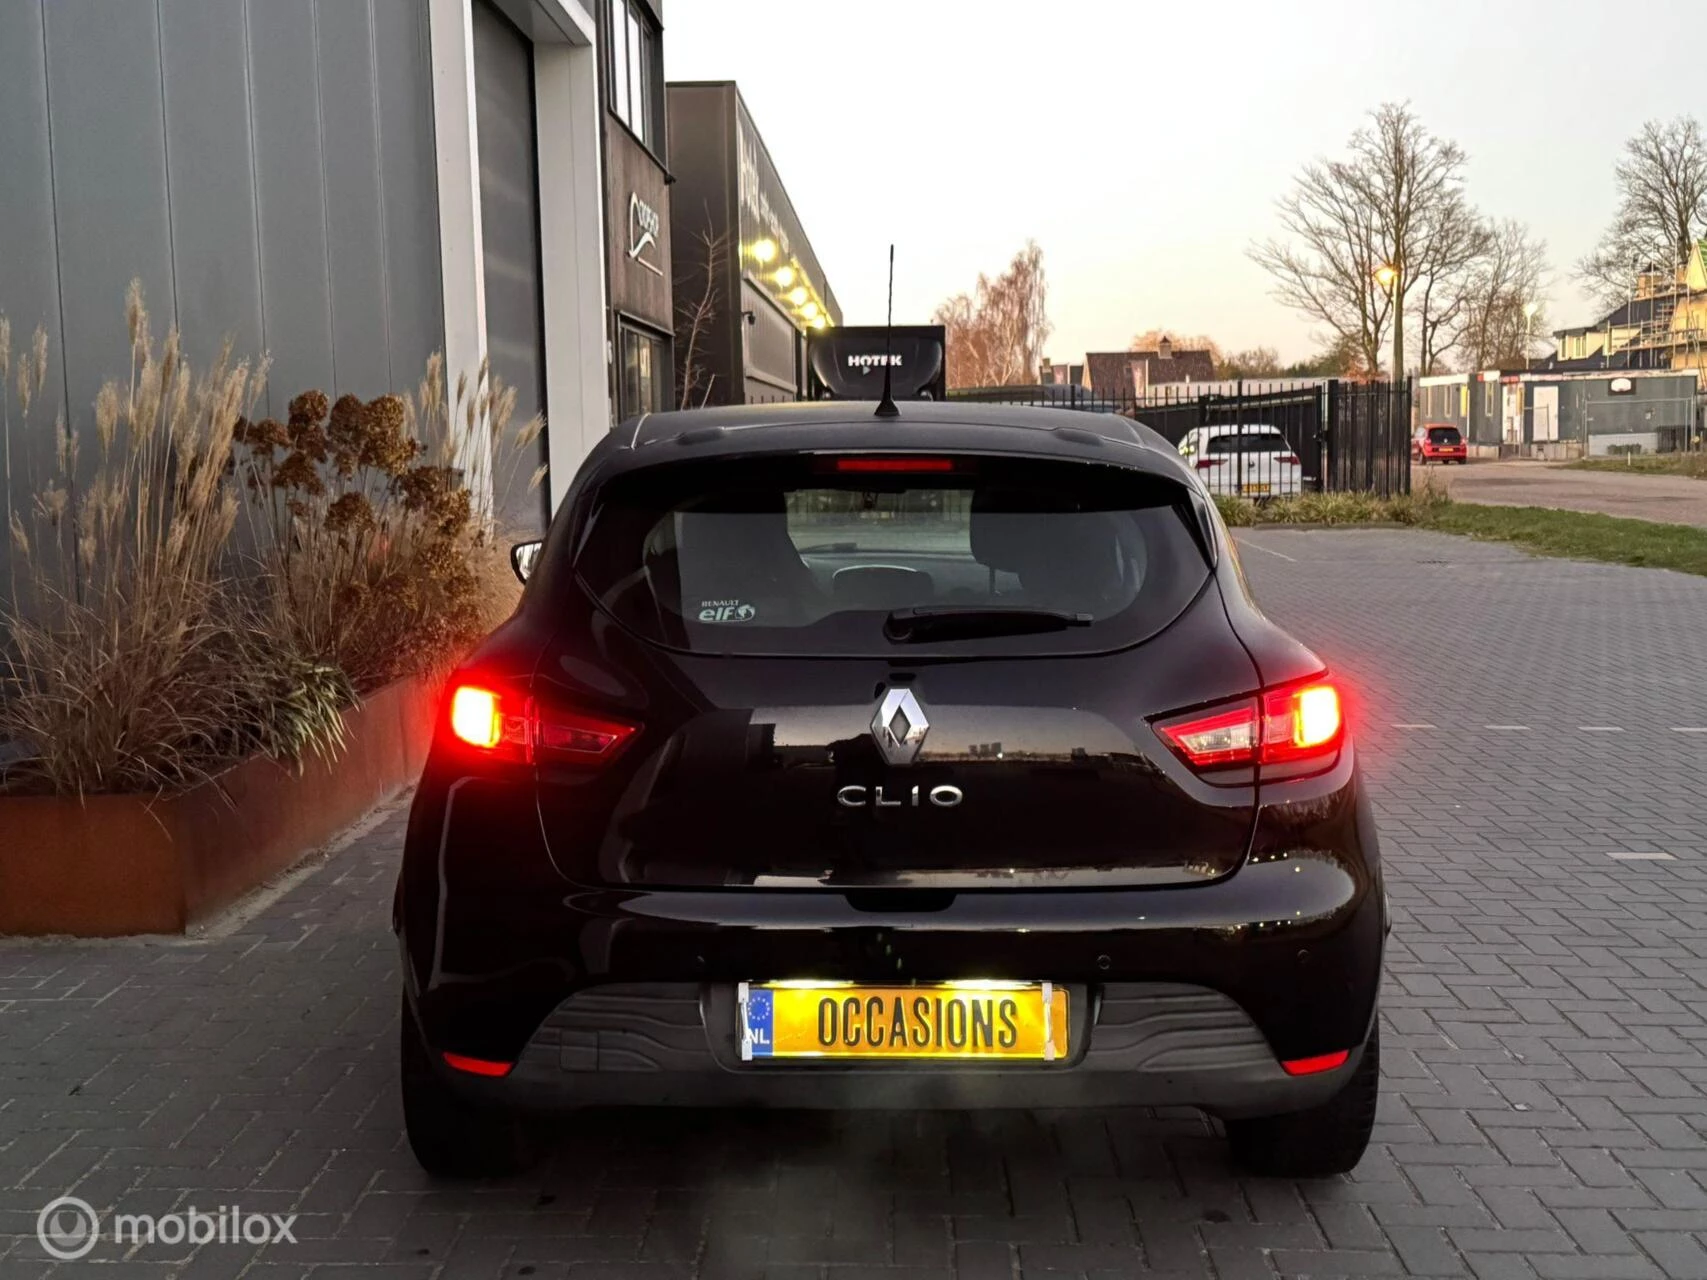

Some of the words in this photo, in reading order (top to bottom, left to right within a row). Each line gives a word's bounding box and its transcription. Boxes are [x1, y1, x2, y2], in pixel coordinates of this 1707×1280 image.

[837, 785, 963, 806] CLIO
[818, 997, 1018, 1048] OCCASIONS
[747, 1028, 770, 1044] NL
